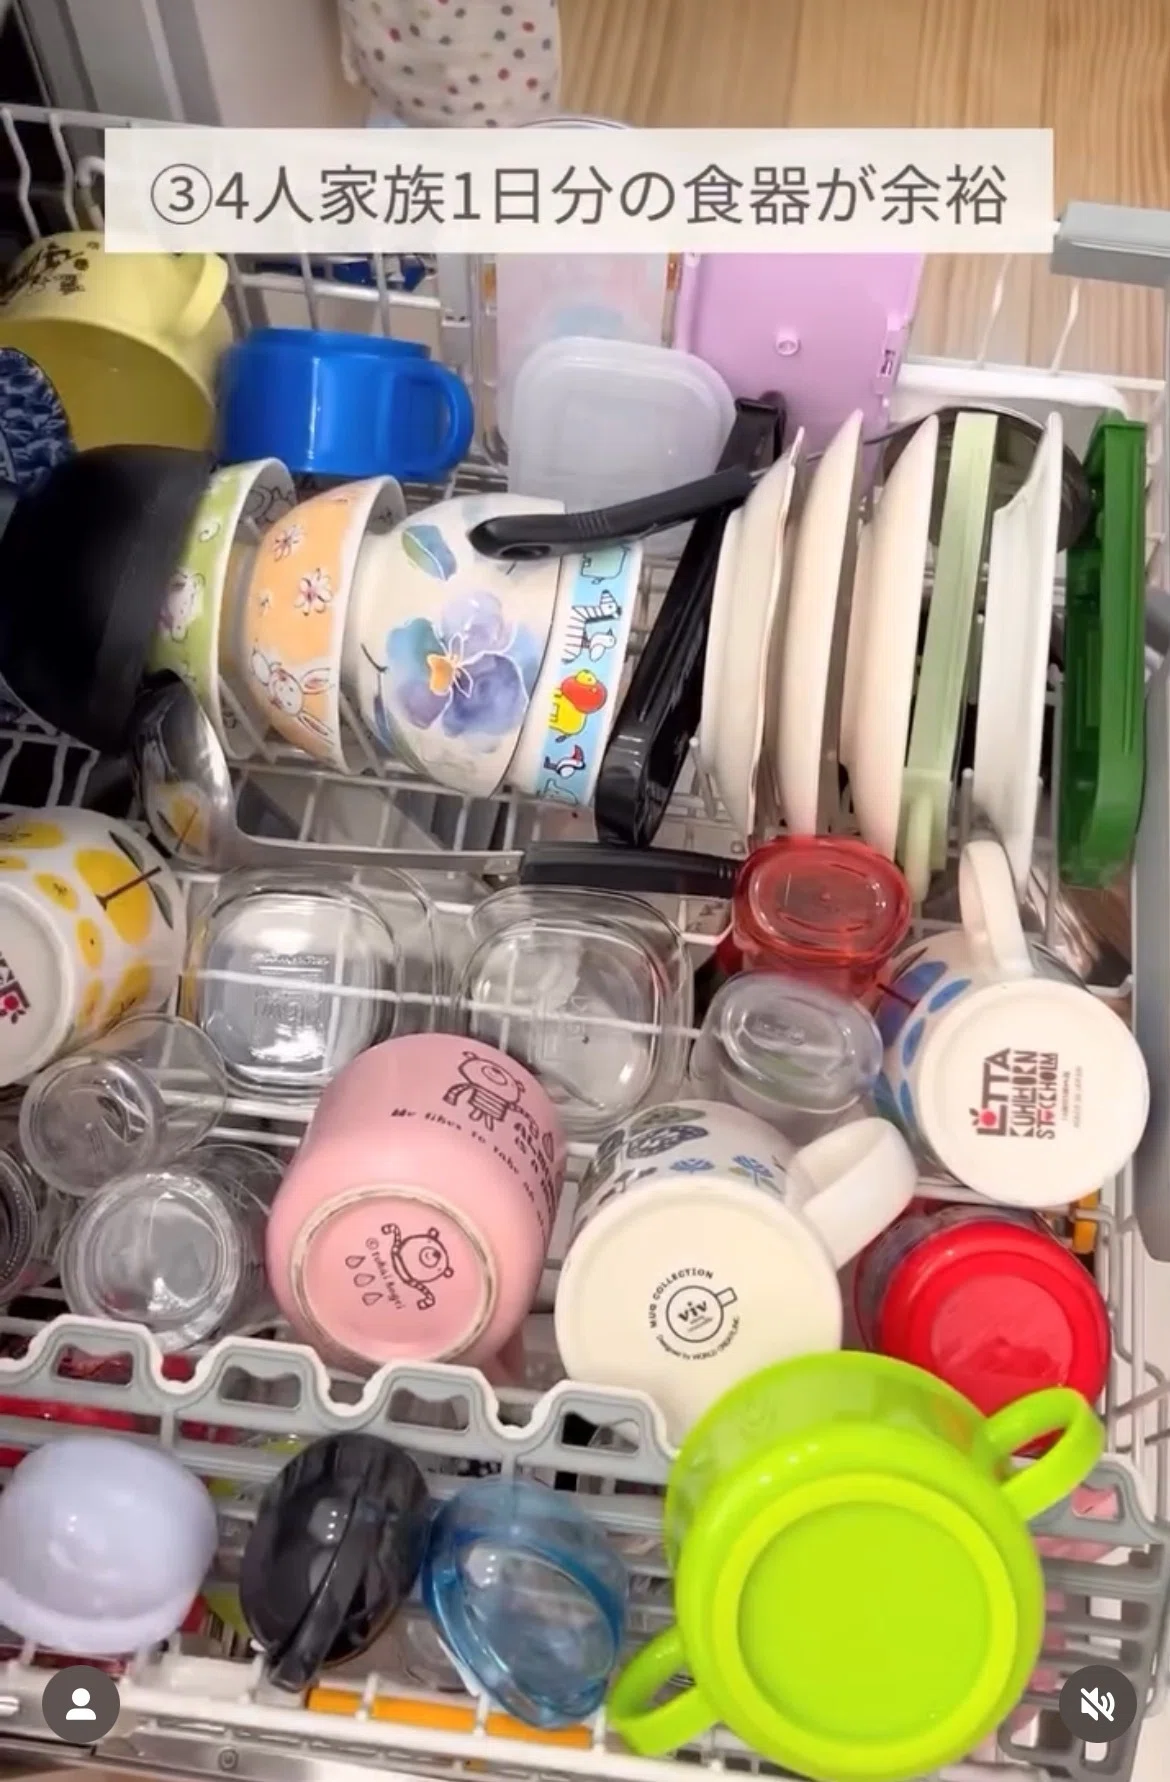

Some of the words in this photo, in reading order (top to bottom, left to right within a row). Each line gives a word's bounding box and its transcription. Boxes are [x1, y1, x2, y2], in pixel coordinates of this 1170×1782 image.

[652, 1267, 714, 1301] COLLECTION
[648, 1303, 658, 1328] MUG
[677, 1300, 707, 1322] viv
